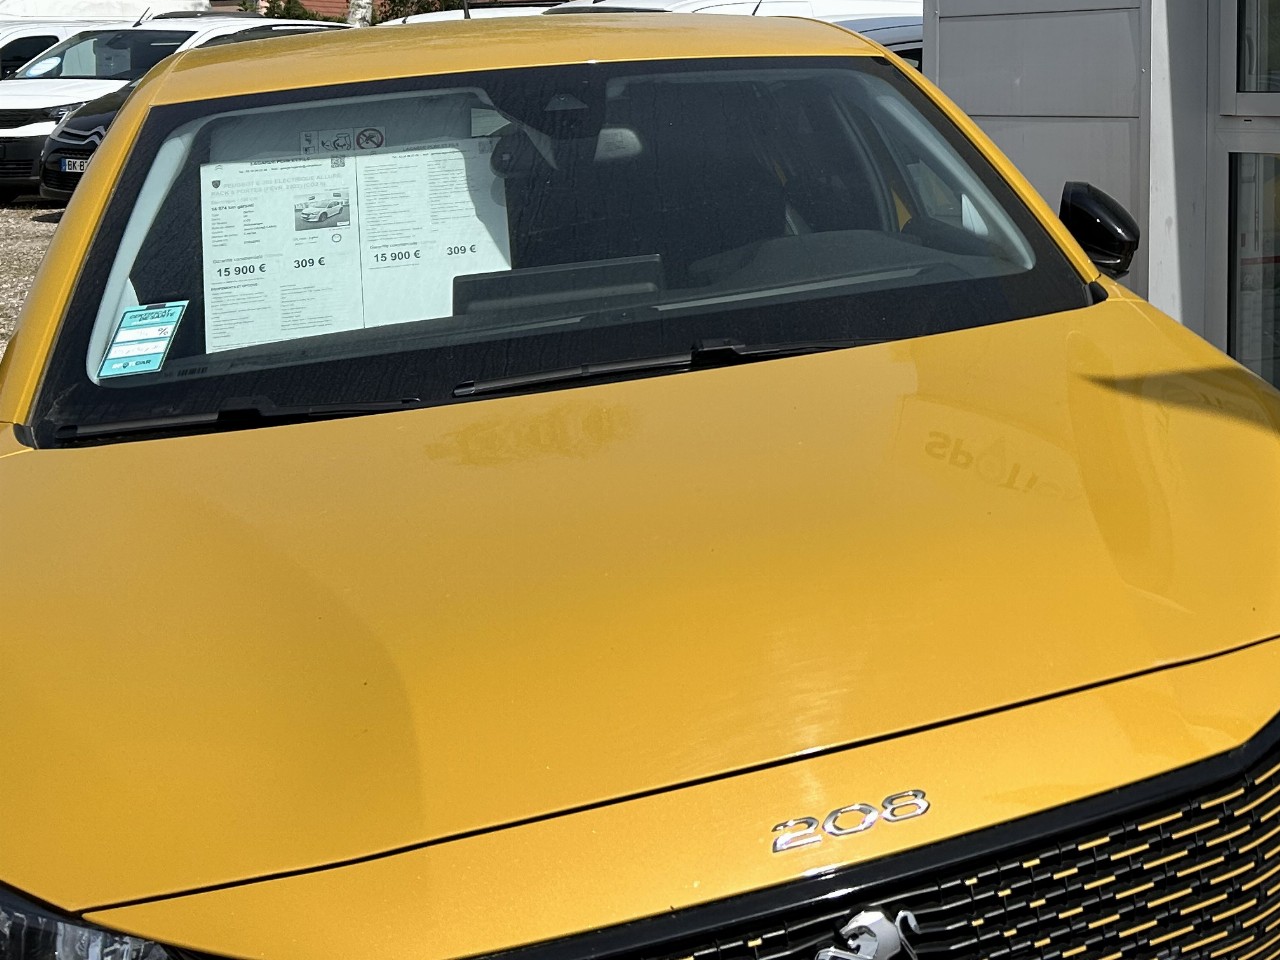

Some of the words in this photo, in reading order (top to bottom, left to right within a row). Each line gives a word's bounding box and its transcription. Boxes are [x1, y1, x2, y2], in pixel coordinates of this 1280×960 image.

[67, 160, 88, 171] BK-8
[447, 246, 466, 255] 309
[470, 244, 476, 253] €
[374, 253, 387, 262] 15
[390, 251, 410, 261] 900
[414, 250, 421, 258] €
[294, 258, 315, 269] 309
[318, 257, 325, 266] €
[217, 268, 230, 277] 15
[234, 265, 255, 276] 900
[259, 264, 266, 272] €
[771, 789, 931, 853] 208
